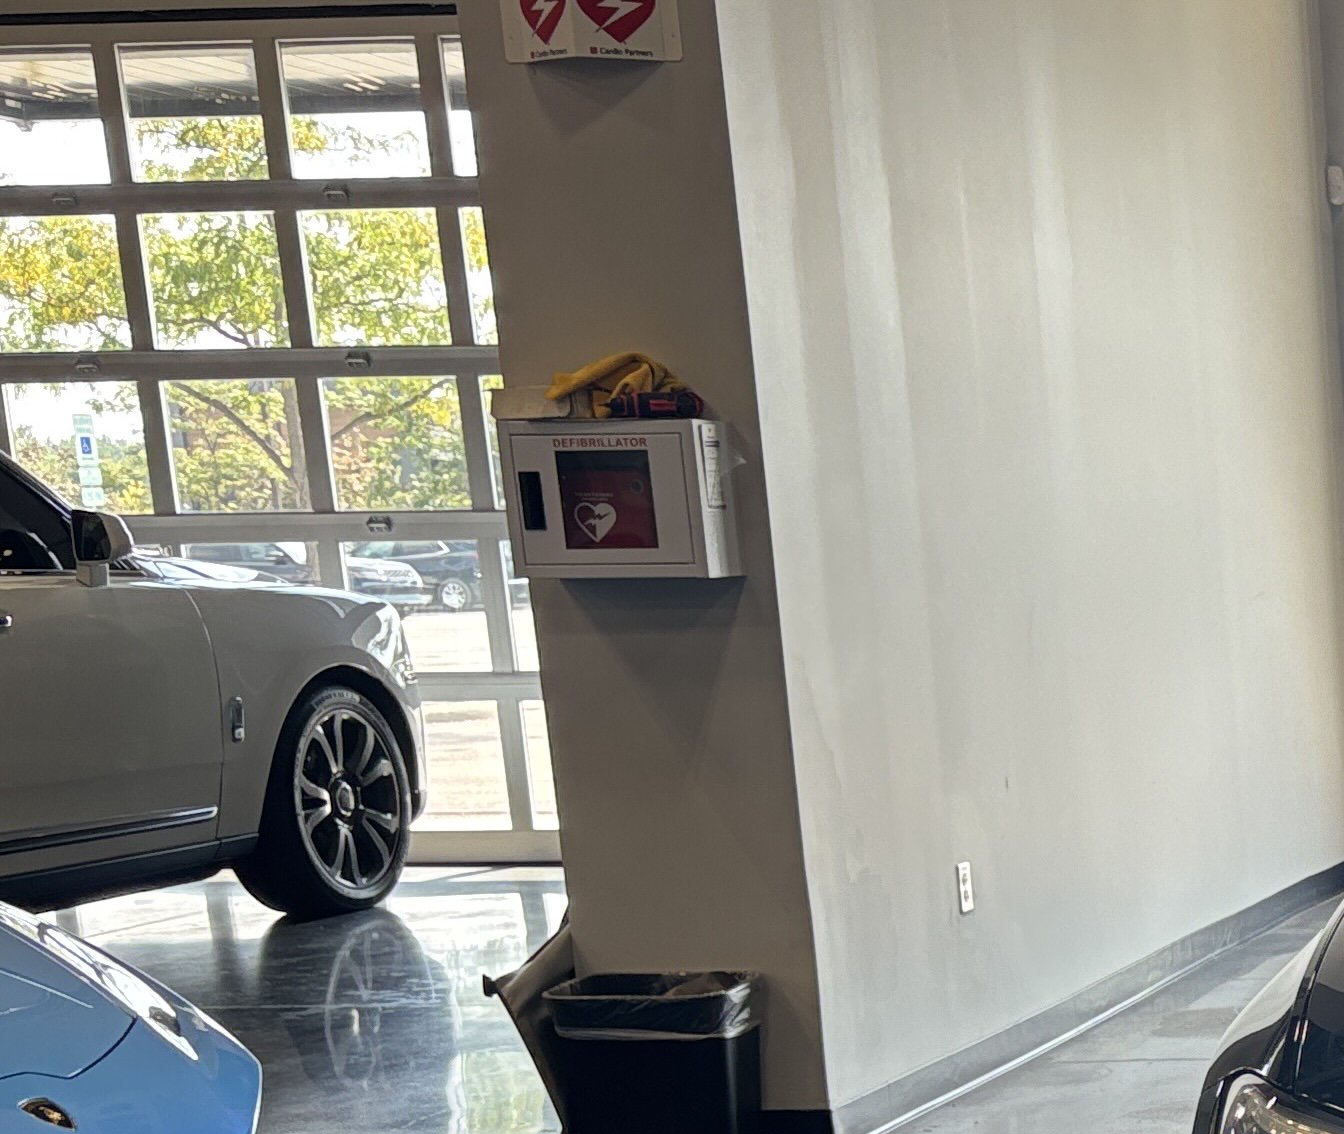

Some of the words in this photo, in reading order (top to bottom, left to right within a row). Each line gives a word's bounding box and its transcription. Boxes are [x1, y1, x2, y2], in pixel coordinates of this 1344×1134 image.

[600, 47, 623, 55] Cardio
[625, 48, 653, 57] Partners
[552, 437, 648, 448] DEFIBRILLATOR
